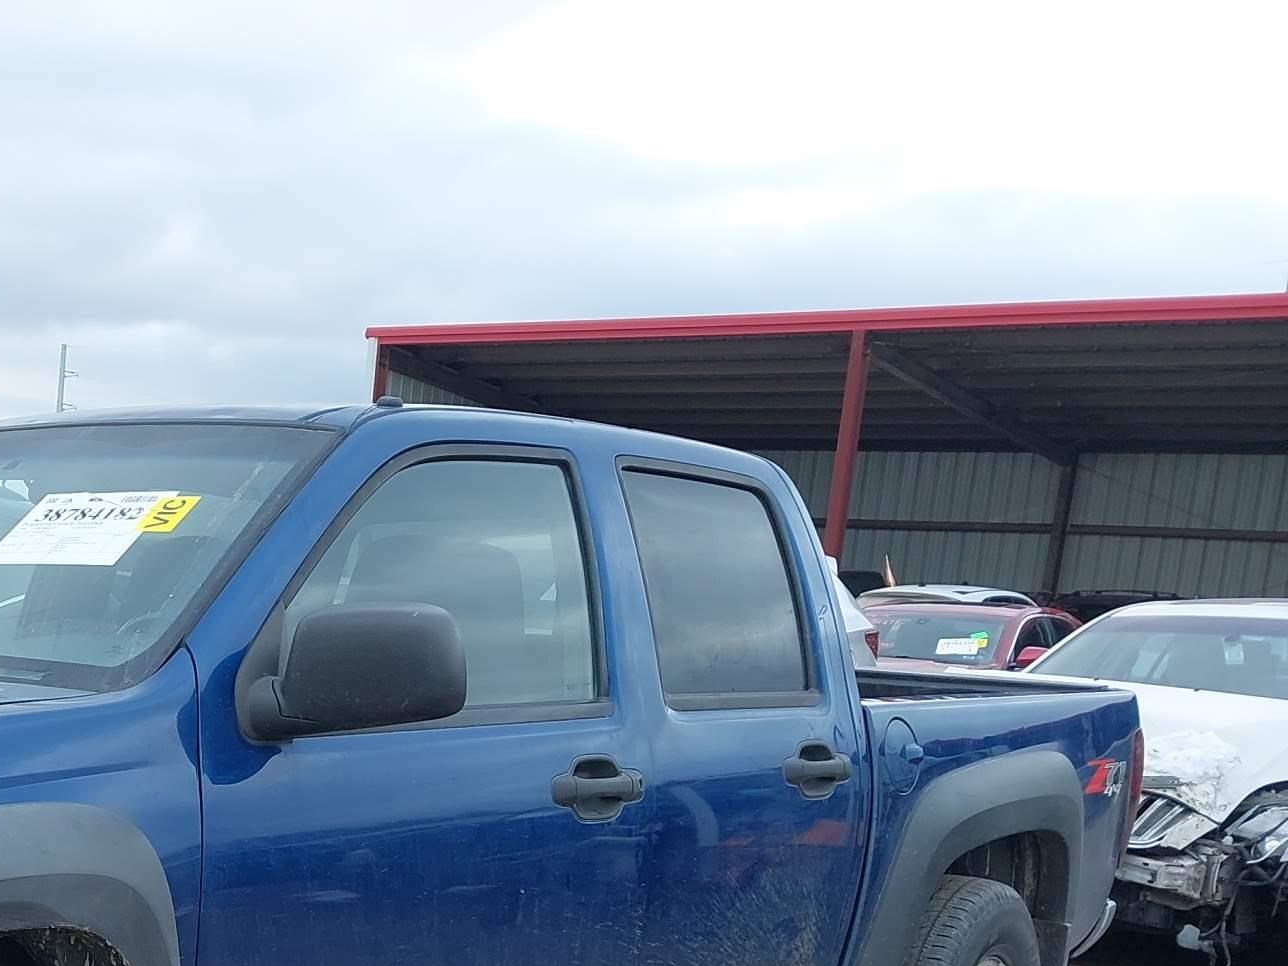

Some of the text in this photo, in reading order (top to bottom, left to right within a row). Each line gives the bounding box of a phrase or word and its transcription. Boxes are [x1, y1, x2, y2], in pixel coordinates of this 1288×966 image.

[35, 507, 145, 522] 38784182
[144, 498, 187, 529] VIC
[1085, 757, 1127, 795] Z71
